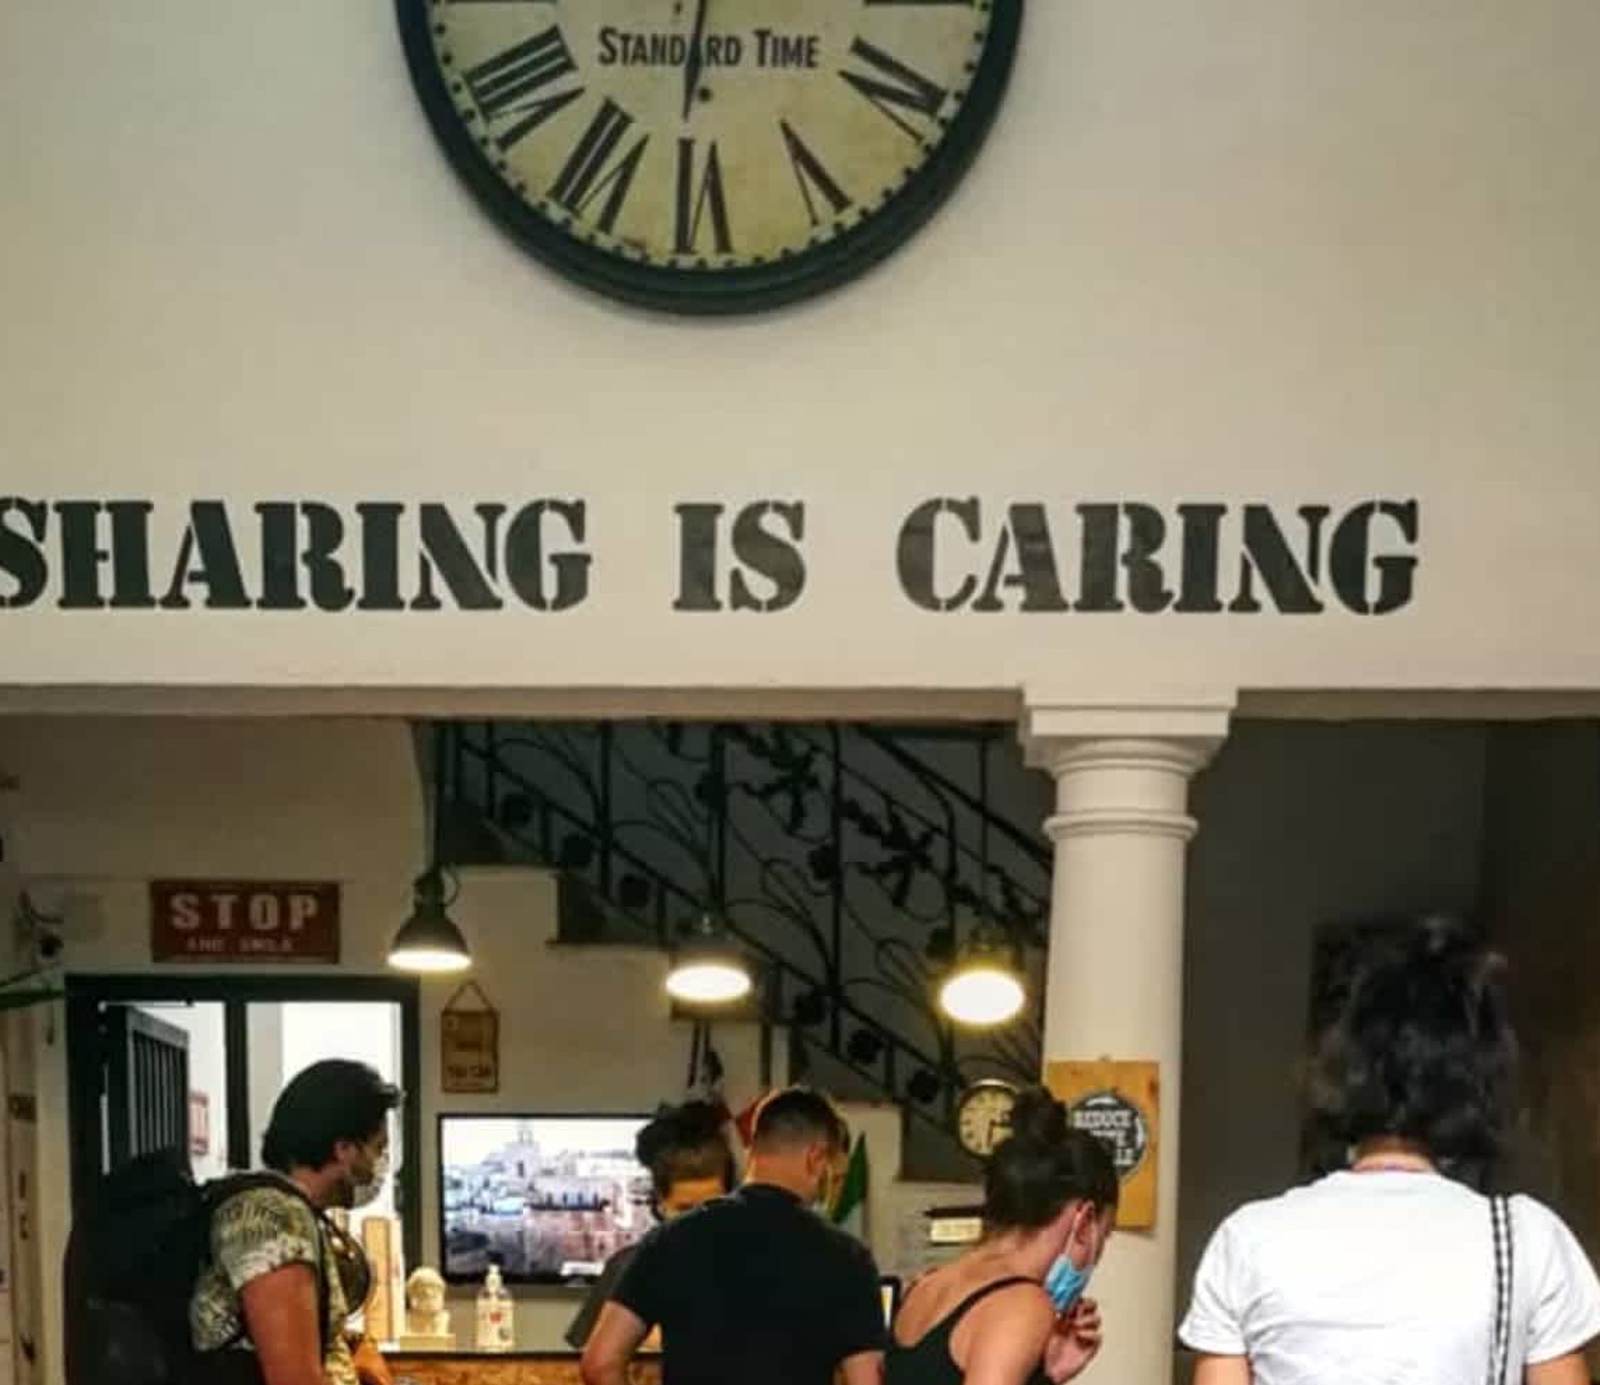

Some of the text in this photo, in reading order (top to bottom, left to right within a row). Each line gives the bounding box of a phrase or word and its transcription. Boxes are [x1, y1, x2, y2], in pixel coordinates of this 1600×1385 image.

[755, 28, 820, 68] TIME
[0, 496, 1420, 615] SHARING IS CARING
[170, 893, 319, 931] STOP
